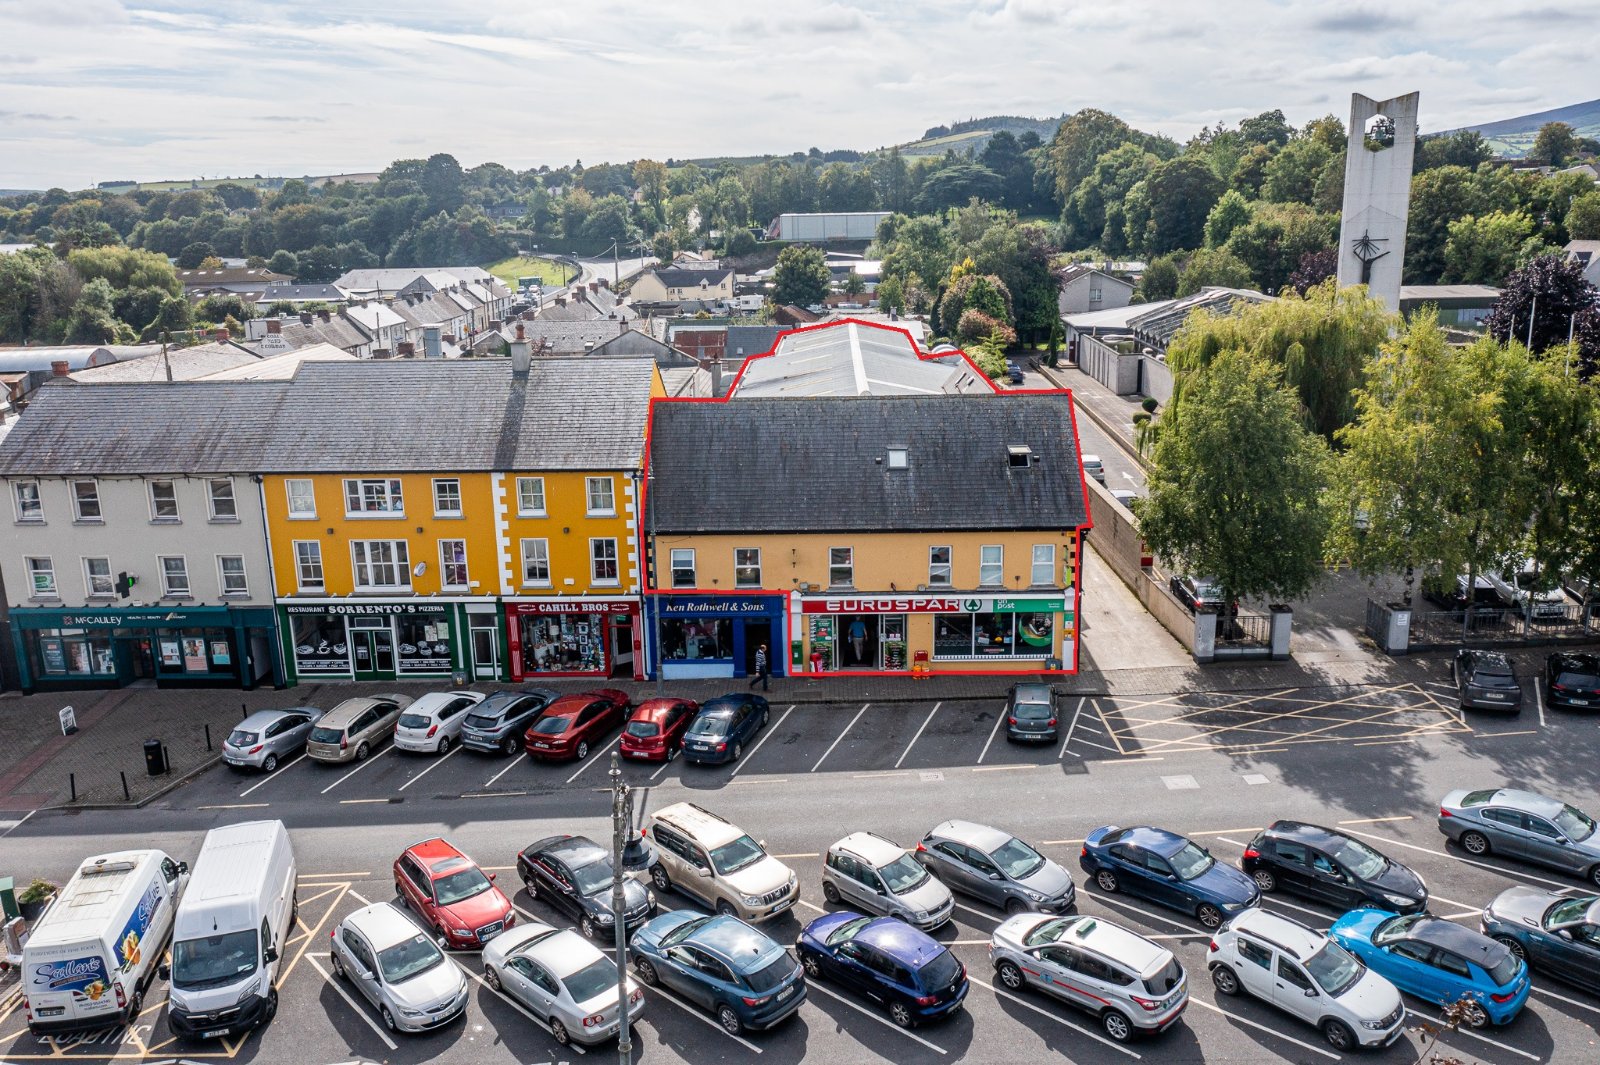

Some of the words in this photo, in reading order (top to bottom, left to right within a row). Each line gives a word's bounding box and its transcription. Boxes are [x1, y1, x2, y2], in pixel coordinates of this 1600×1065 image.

[328, 605, 416, 614] SORRENTO'S
[538, 604, 579, 612] CAHILL
[581, 603, 609, 612] BROS
[666, 603, 685, 612] Ken
[686, 602, 729, 612] Rothwell
[730, 603, 739, 611] &
[741, 602, 765, 611] Sons
[826, 599, 959, 611] EUROSPAR
